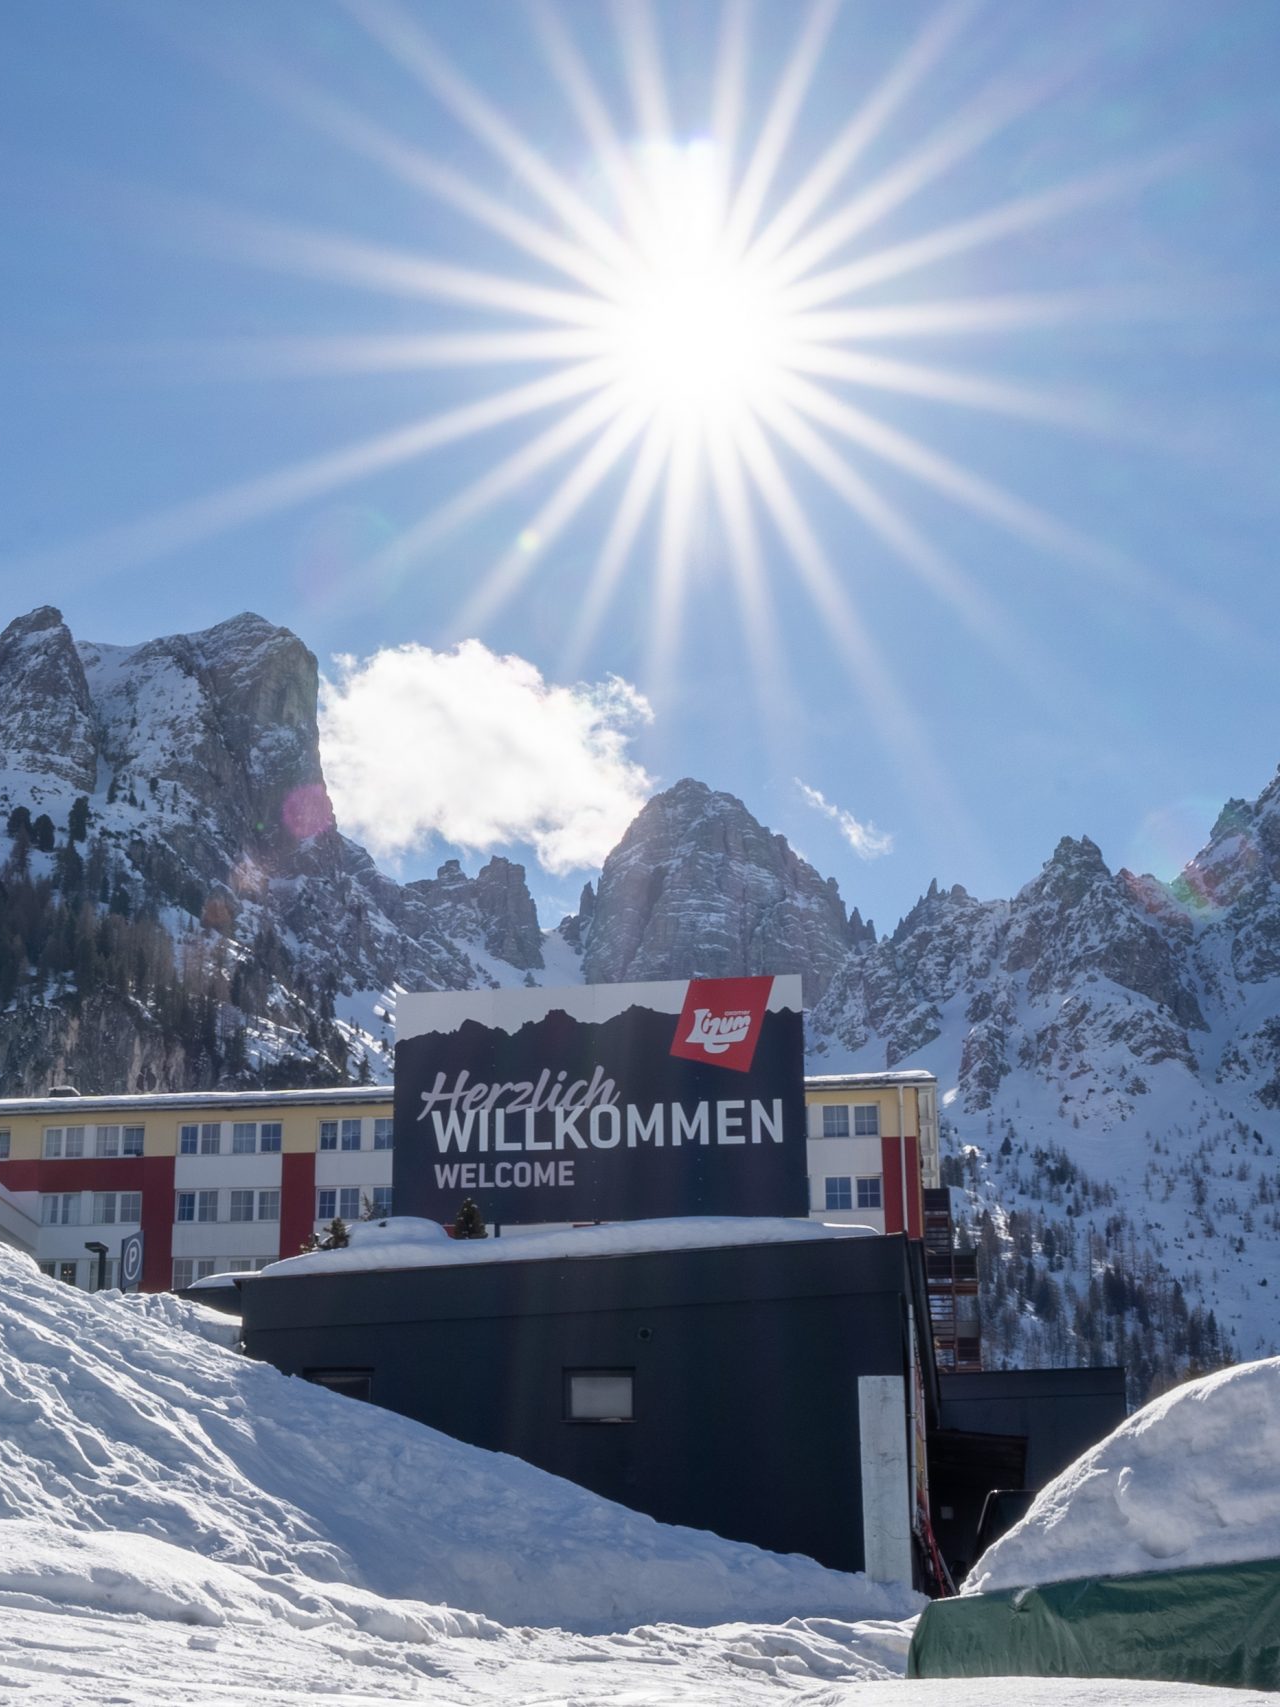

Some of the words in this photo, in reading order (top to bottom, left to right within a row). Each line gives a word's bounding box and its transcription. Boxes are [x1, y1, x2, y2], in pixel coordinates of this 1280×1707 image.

[685, 1008, 751, 1053] Lizum
[417, 1065, 620, 1121] Herzlich
[431, 1099, 783, 1153] WILLKOMMEN
[434, 1161, 575, 1189] WELCOME
[128, 1246, 137, 1273] P
